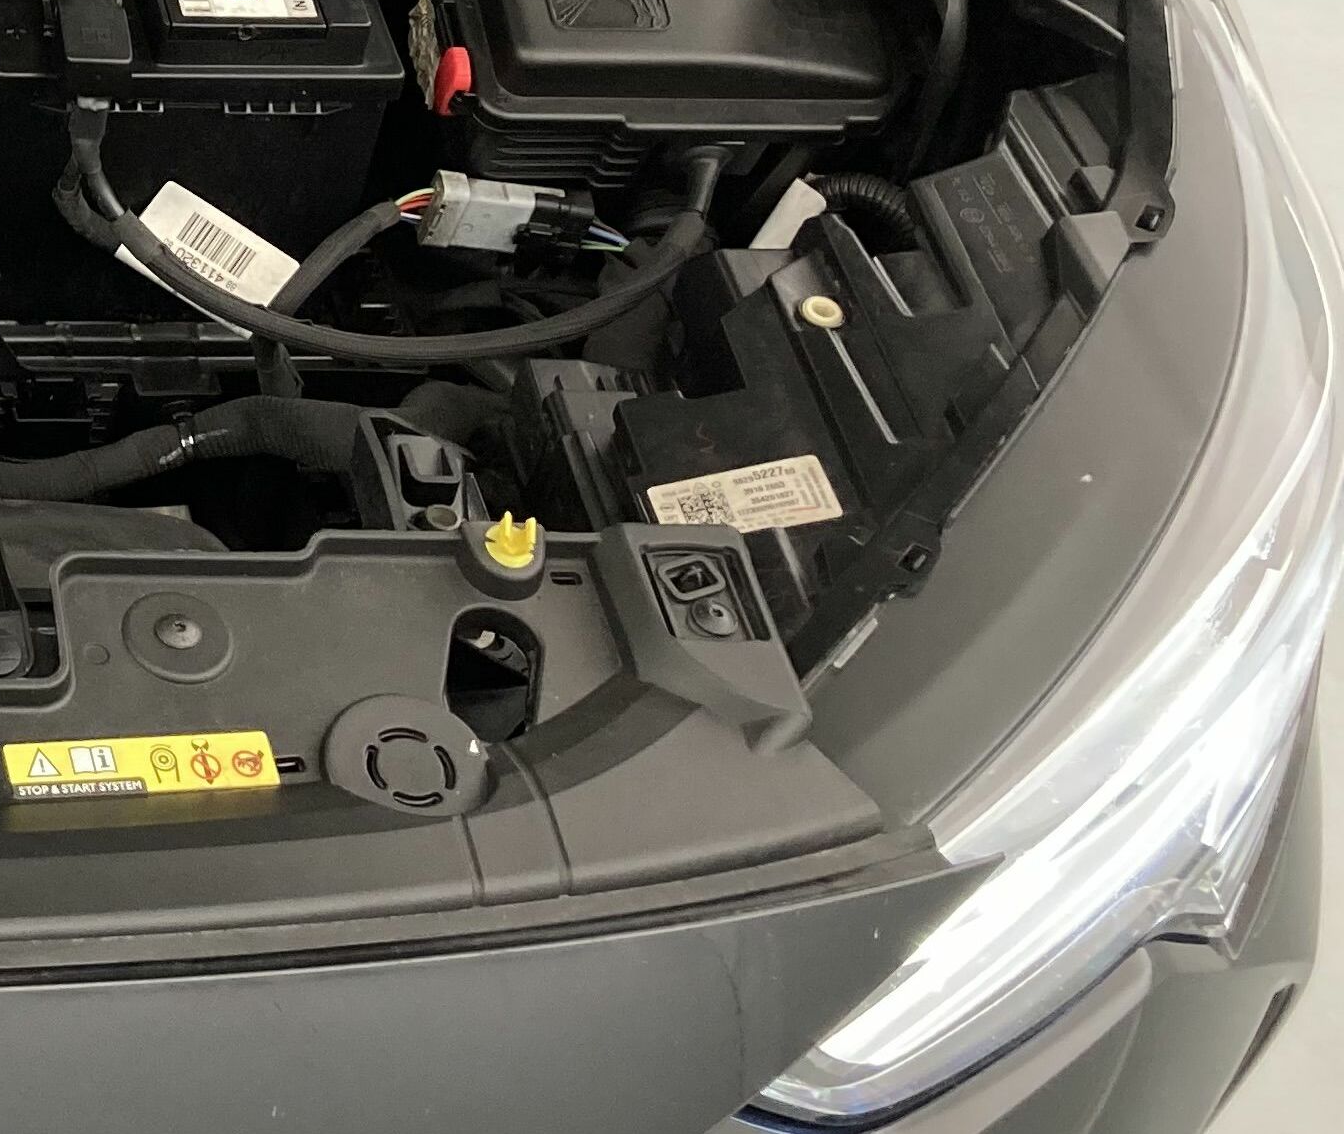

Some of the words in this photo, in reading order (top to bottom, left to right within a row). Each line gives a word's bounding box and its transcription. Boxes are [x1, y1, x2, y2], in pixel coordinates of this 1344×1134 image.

[175, 247, 224, 282] 411320
[18, 785, 49, 796] STOP
[51, 784, 61, 795] &
[61, 782, 97, 794] START
[98, 780, 143, 792] SYSTEM
